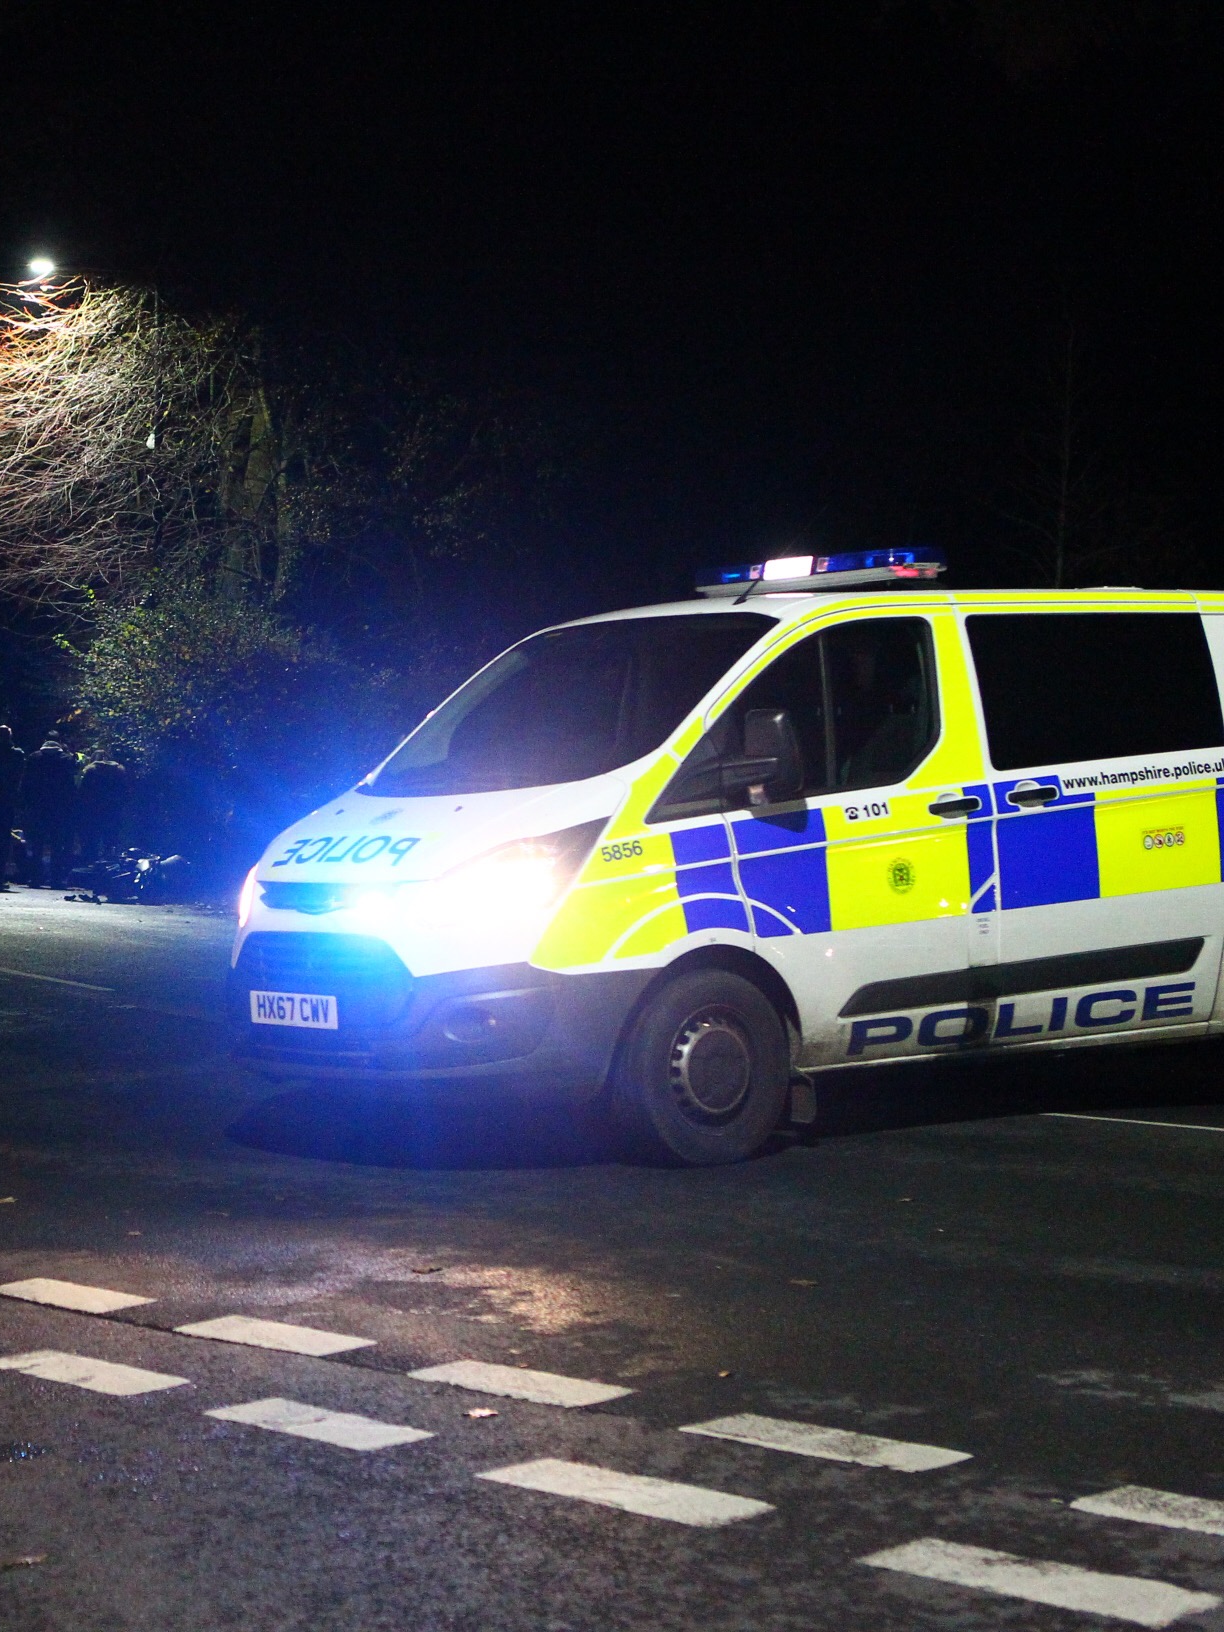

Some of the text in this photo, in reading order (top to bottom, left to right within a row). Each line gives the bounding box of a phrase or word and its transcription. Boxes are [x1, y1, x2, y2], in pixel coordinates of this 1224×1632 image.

[863, 802, 889, 817] 101
[601, 840, 643, 862] 5856
[257, 995, 329, 1023] HX67 CWV
[846, 982, 1196, 1056] POLICE
